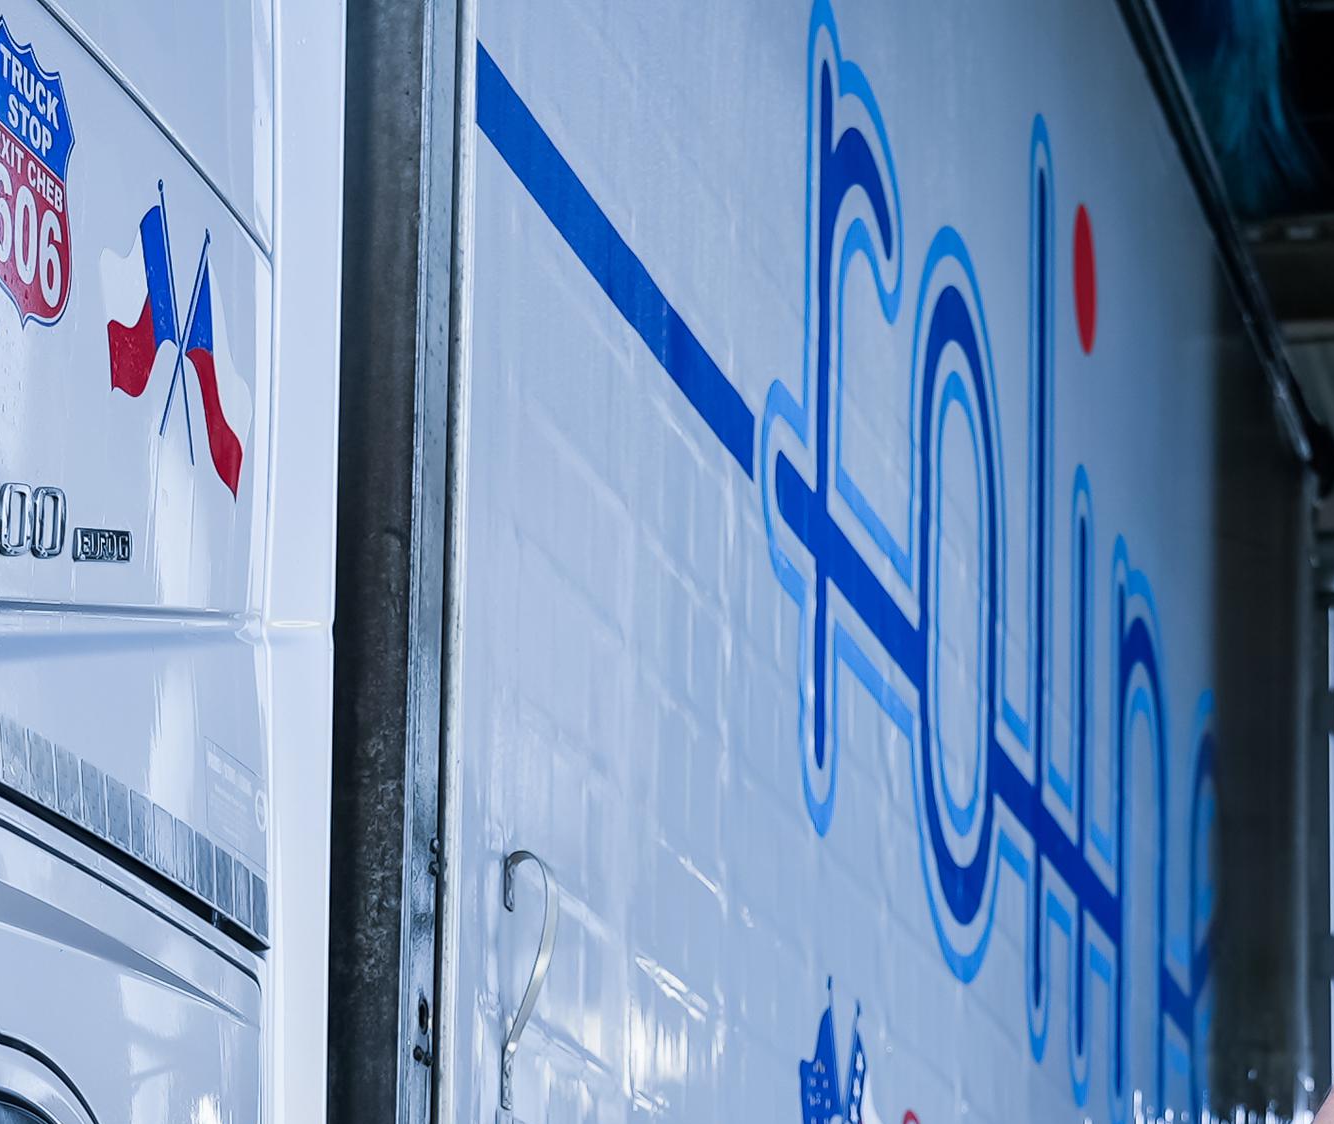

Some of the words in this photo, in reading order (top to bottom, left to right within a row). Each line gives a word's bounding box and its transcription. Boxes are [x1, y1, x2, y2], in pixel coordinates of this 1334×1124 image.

[0, 43, 60, 131] TRUCK
[7, 93, 53, 156] STOP
[27, 161, 64, 213] CHEB
